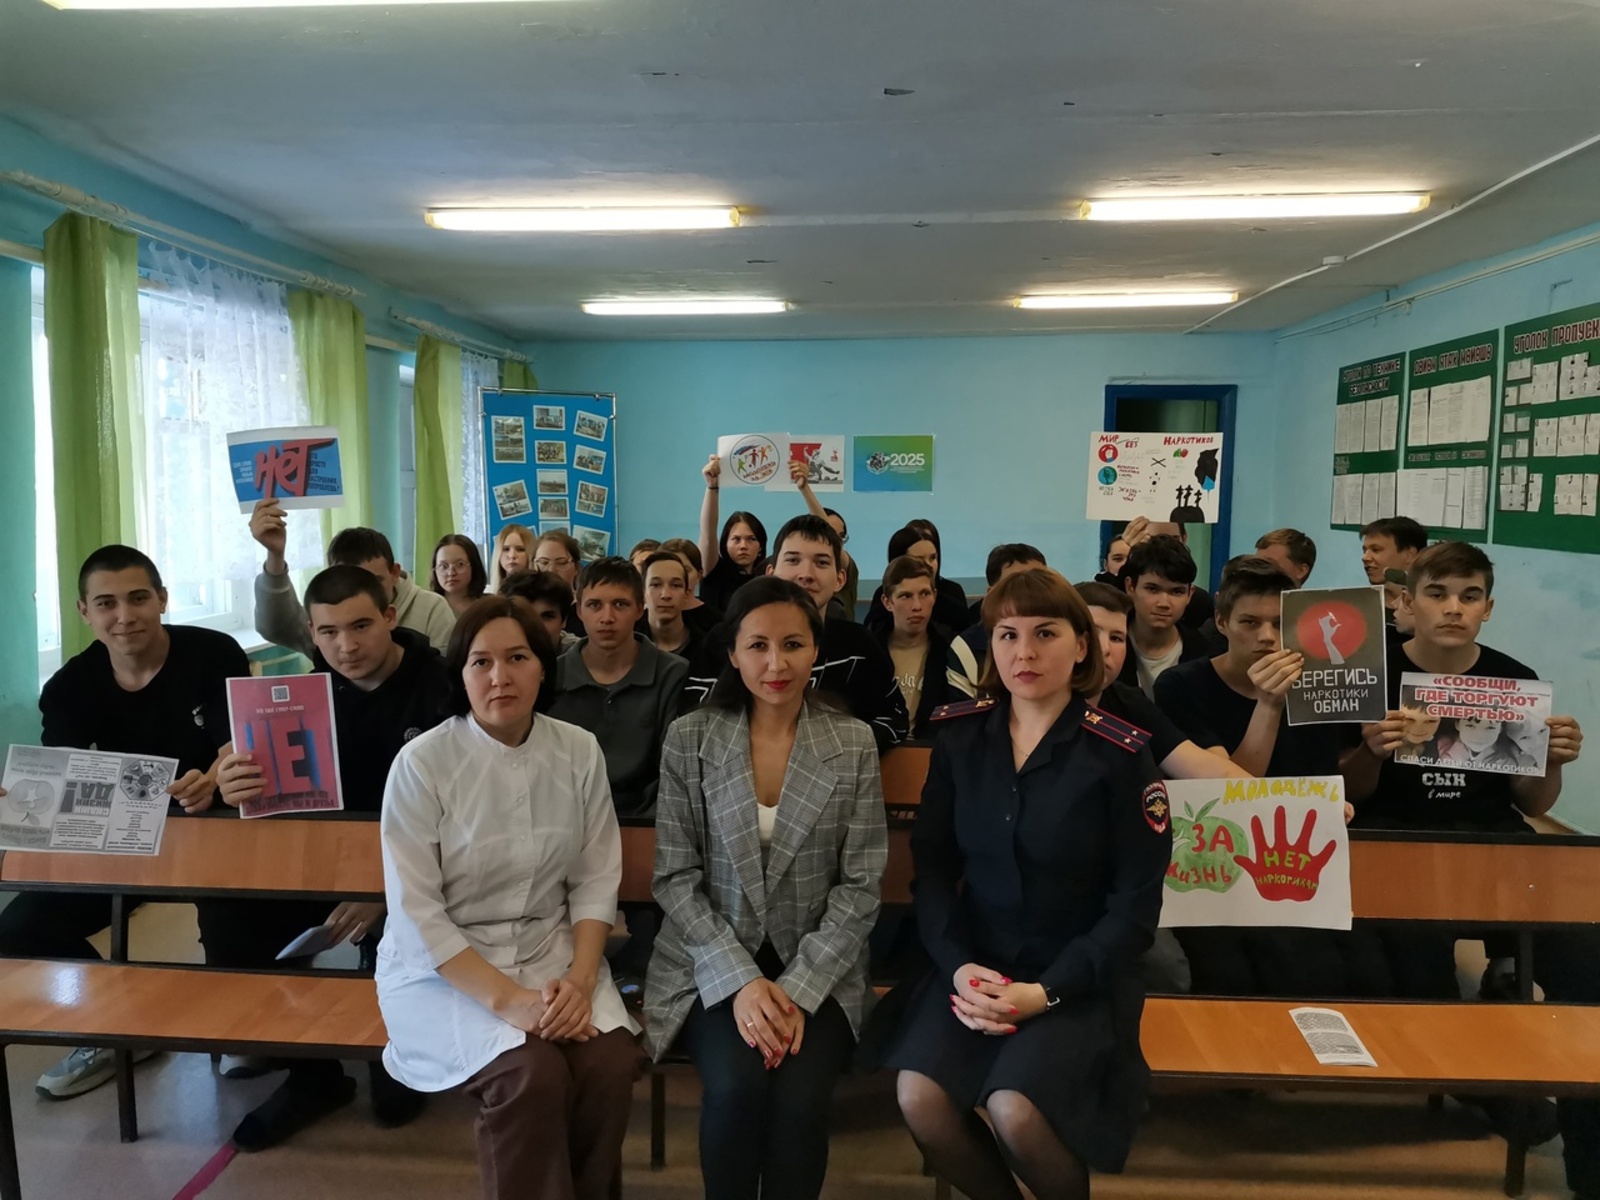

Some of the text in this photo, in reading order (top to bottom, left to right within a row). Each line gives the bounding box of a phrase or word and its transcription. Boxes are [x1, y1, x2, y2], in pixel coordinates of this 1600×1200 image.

[1514, 329, 1548, 354] УГОЛОК
[1099, 435, 1119, 443] МИР
[890, 453, 925, 466] 2025
[254, 438, 336, 500] НЕТ
[1433, 675, 1521, 692] «СООБЩИ,
[1303, 688, 1369, 701] НАРКОТИКИ
[1415, 689, 1539, 707] ГДЕ ТОРГУЮТ
[1314, 698, 1360, 713] ОБМАН
[1427, 705, 1525, 721] СМЕРТЬЮ»
[1400, 755, 1434, 764] СПАСИ
[1464, 761, 1478, 769] ОТ
[1422, 772, 1467, 787] СЫН
[1436, 791, 1461, 799] мире
[1192, 823, 1235, 853] ЗА
[1263, 850, 1311, 870] НЕТ
